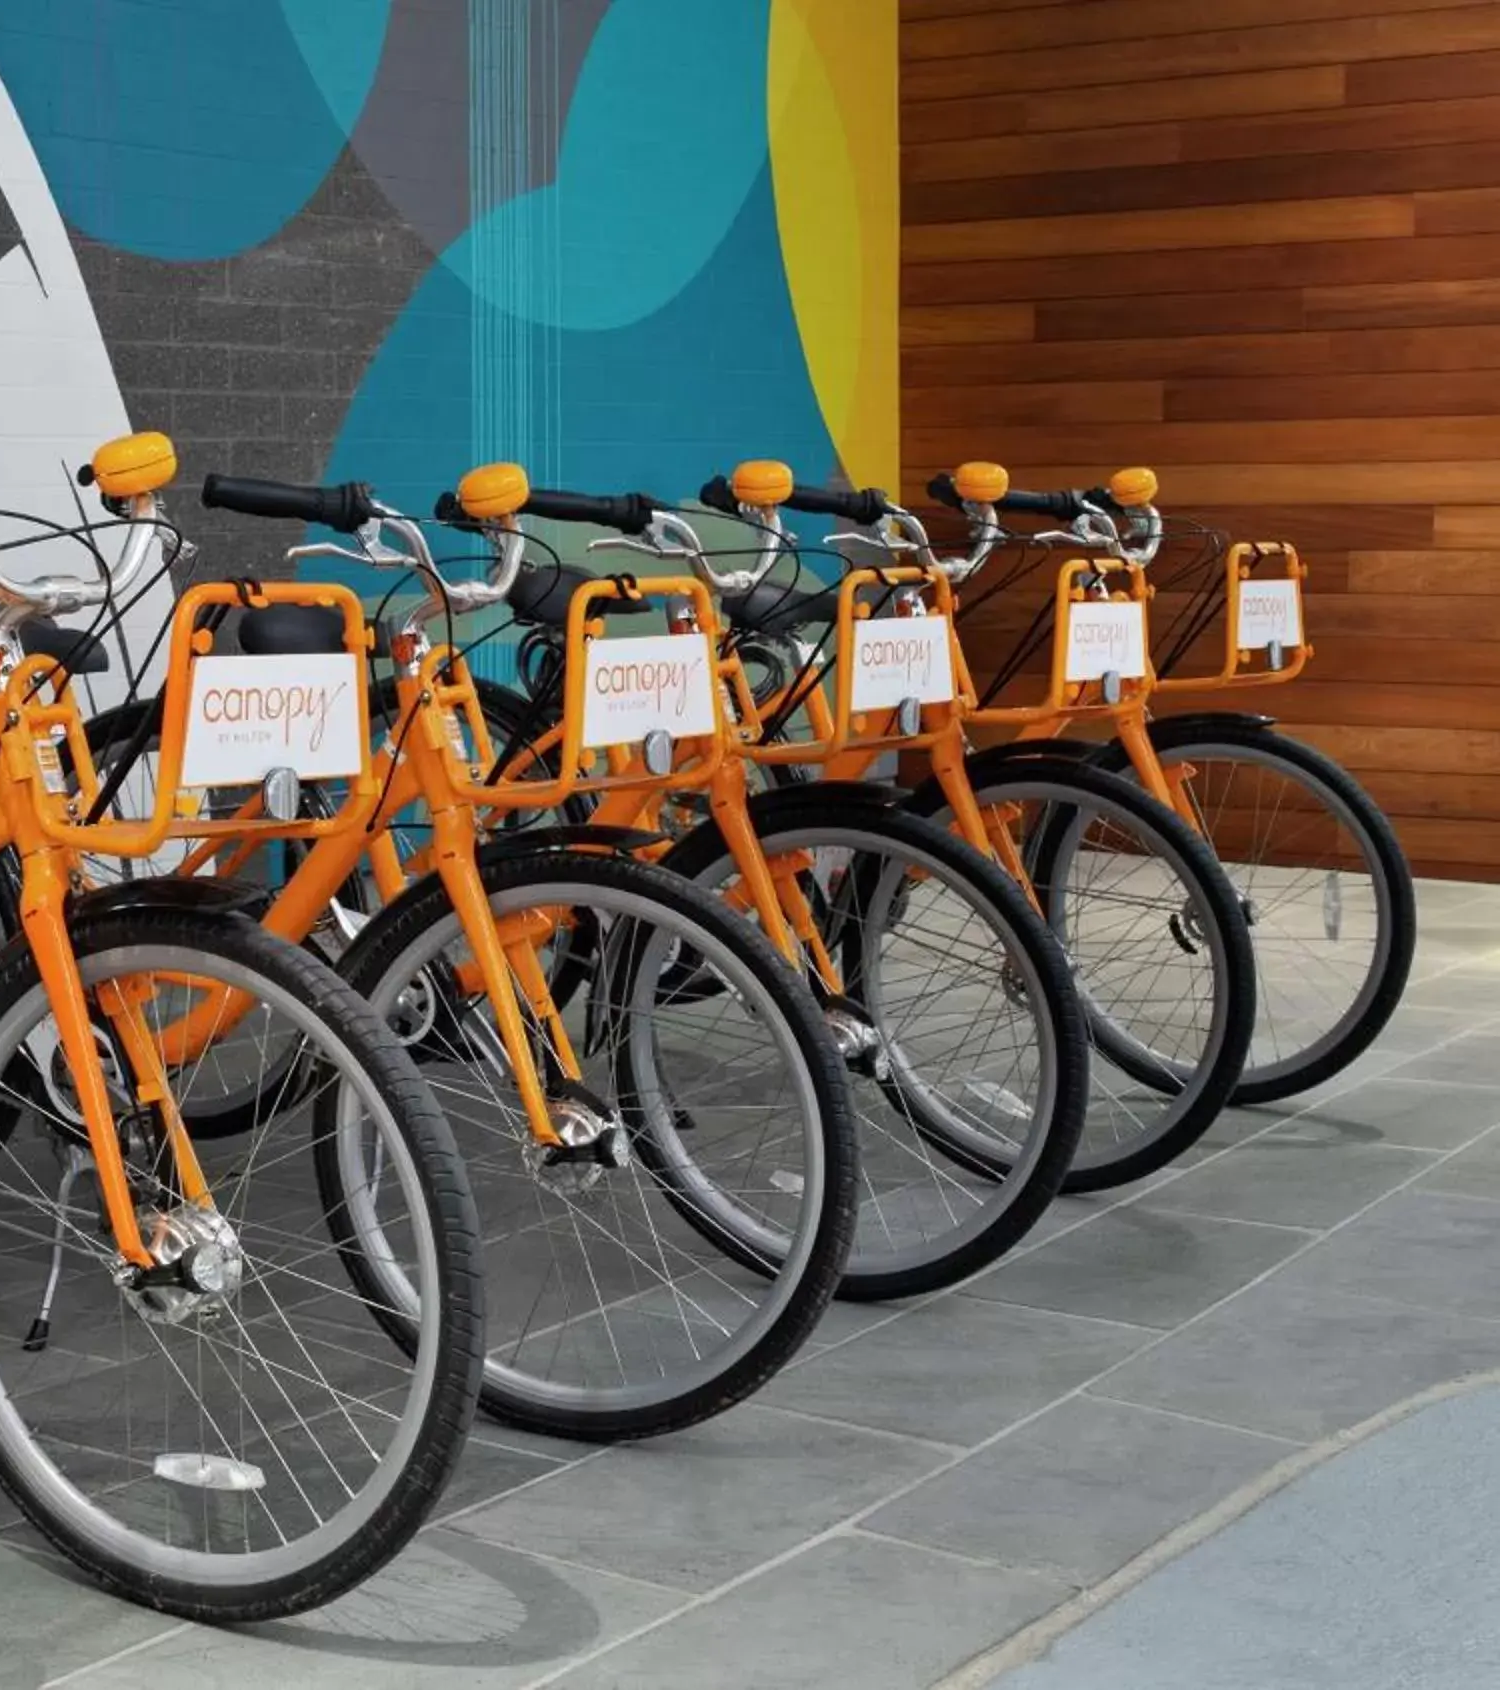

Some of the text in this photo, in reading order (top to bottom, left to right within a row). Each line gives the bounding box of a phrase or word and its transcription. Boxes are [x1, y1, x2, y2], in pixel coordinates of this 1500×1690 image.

[595, 657, 702, 716] canopy
[861, 635, 941, 687] canopy
[203, 682, 347, 752] canopy
